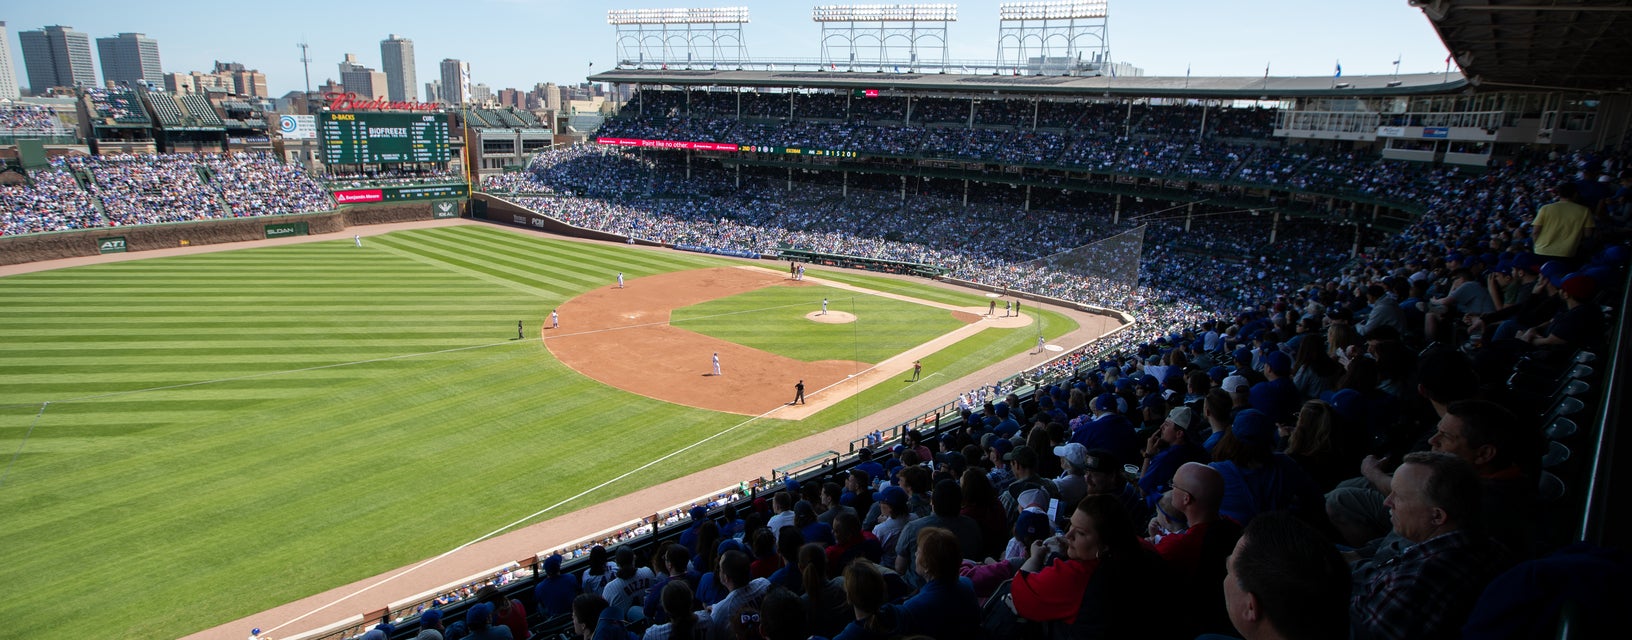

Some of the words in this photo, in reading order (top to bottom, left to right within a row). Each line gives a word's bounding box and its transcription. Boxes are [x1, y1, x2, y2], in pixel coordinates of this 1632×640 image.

[325, 92, 439, 111] Budweiser
[368, 127, 408, 135] BIOFREEZE
[266, 227, 294, 235] SLOAN
[100, 240, 125, 249] ATI
